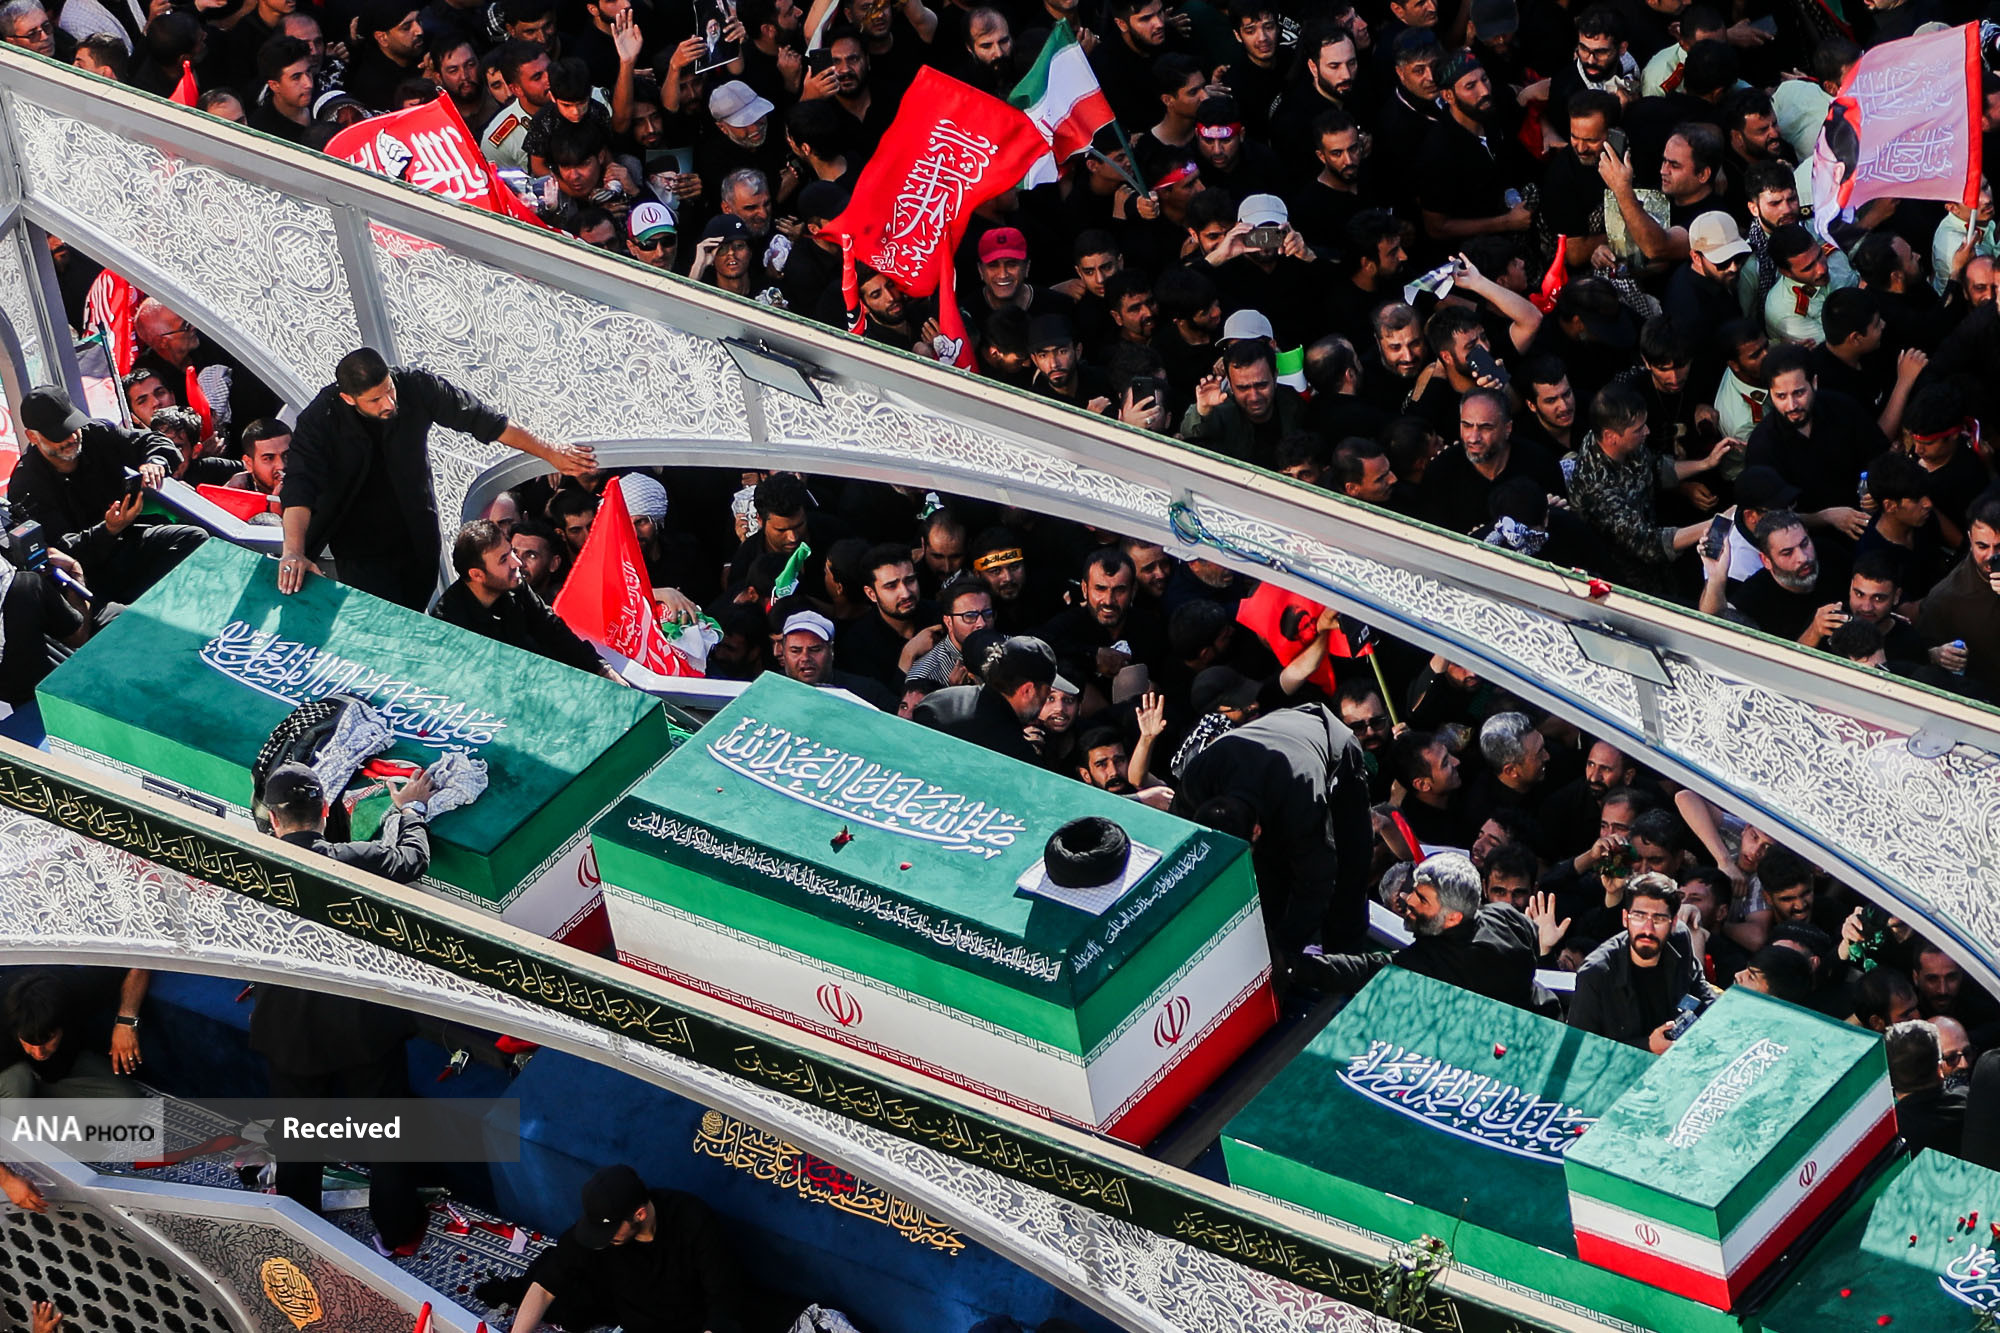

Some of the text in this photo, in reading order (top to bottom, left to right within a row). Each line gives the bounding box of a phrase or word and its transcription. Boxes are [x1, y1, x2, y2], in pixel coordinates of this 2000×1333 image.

[200, 851, 252, 886] عليك
[570, 986, 626, 1021] عليك
[619, 1000, 695, 1053] السلام
[1032, 1157, 1089, 1190] عليك
[1080, 1173, 1133, 1215] السلام
